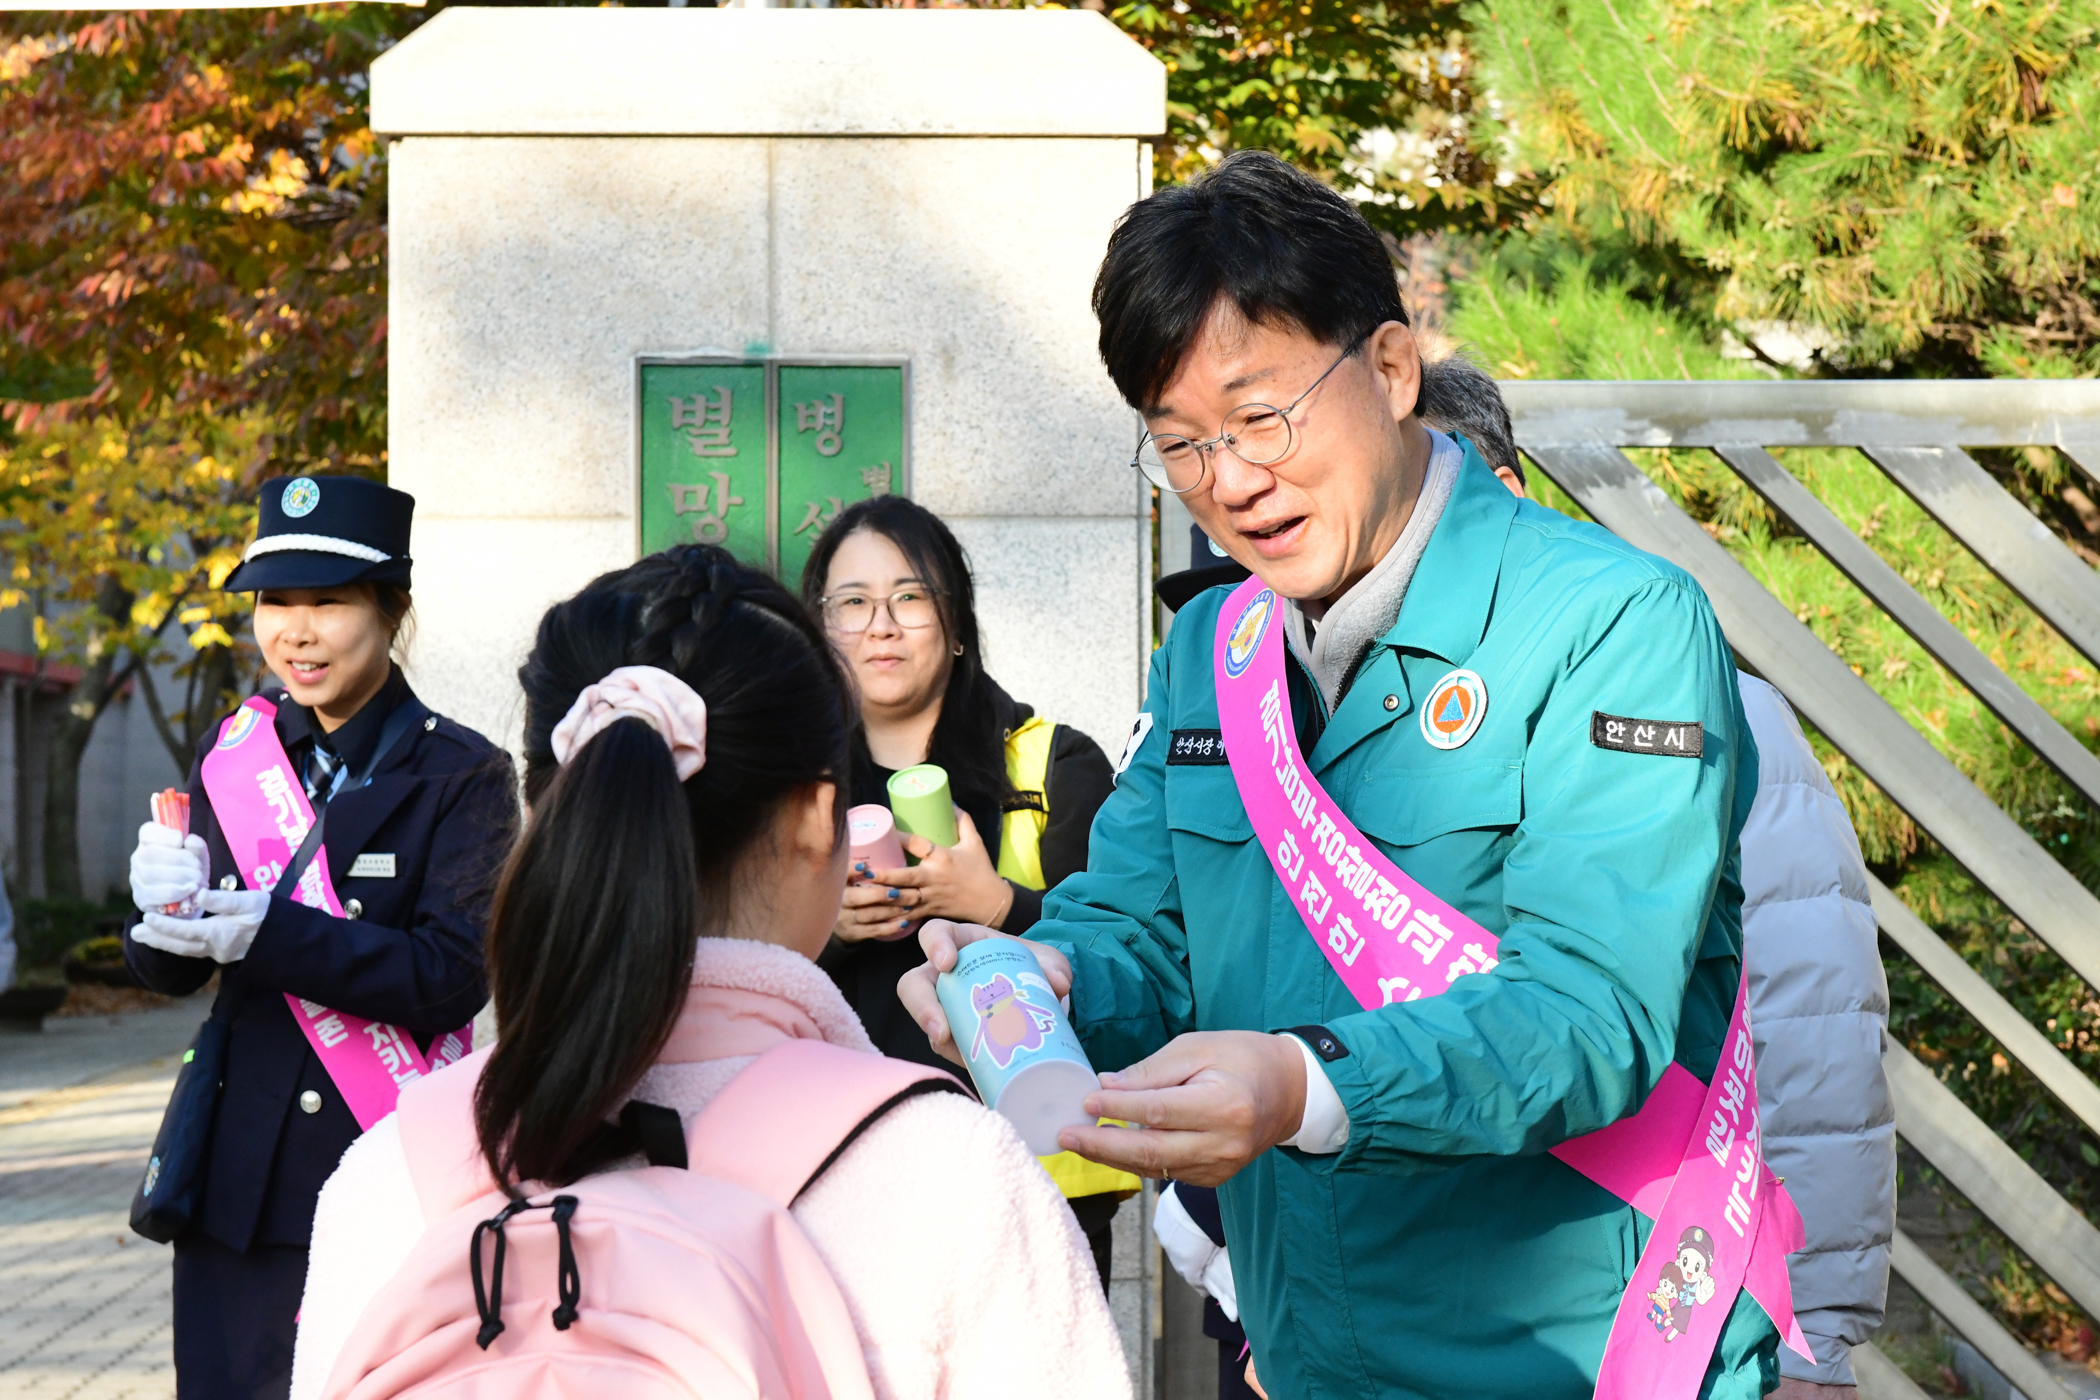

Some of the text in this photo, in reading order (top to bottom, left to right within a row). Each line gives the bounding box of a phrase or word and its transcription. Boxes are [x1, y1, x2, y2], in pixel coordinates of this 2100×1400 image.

[667, 385, 744, 544] 별망
[1175, 735, 1214, 756] 안산시장
[1605, 720, 1685, 750] 안산시
[1259, 679, 1454, 966] 경기남부경찰청과
[1278, 828, 1366, 967] 안전한
